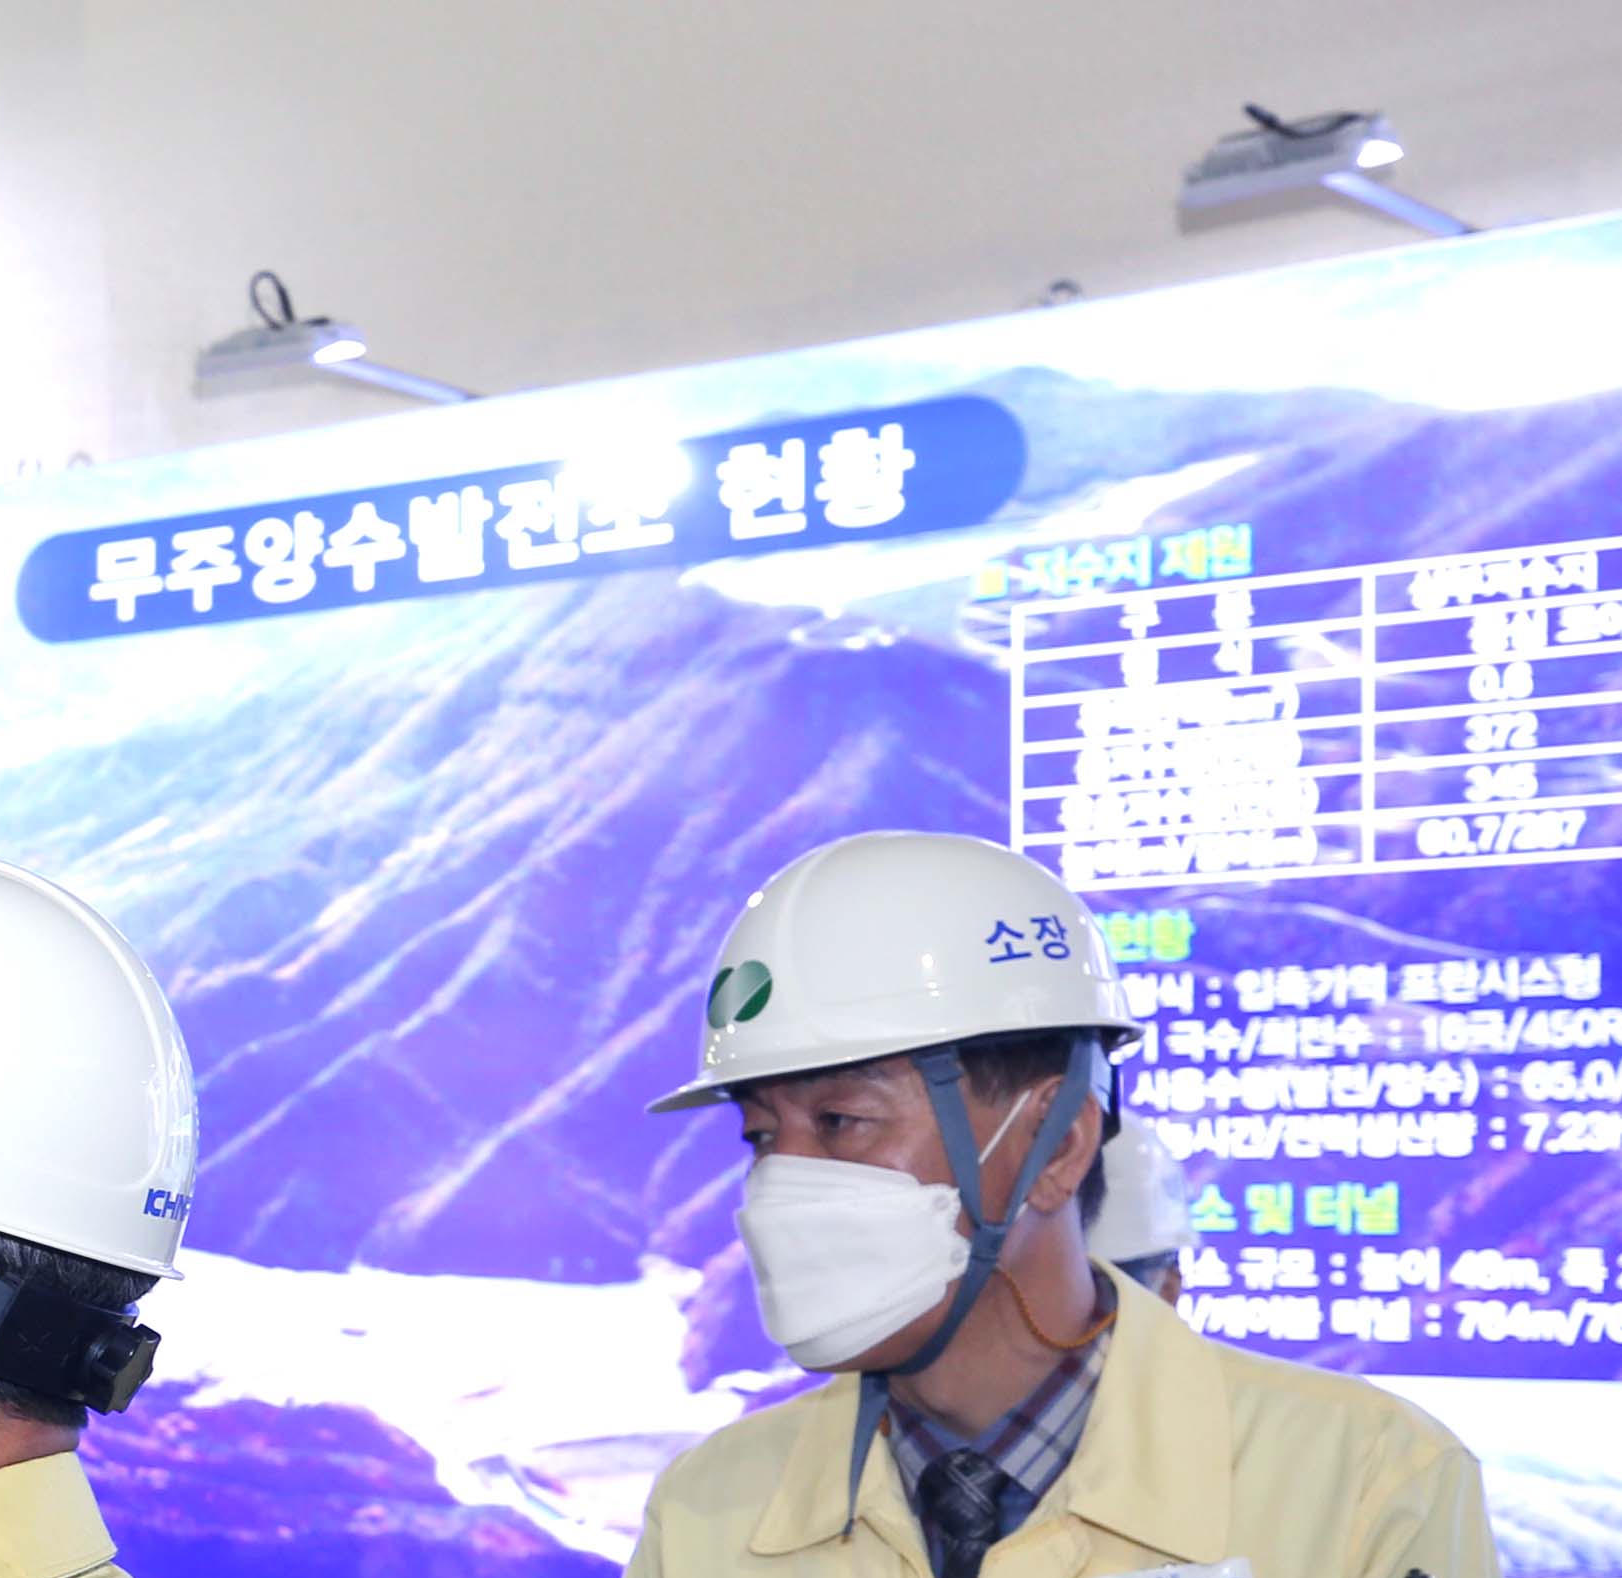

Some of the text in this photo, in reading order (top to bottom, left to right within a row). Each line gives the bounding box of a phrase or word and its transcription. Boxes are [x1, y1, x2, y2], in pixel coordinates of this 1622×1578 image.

[89, 424, 915, 622] 무주양수발전소 현황
[1464, 711, 1538, 752] 372
[984, 914, 1070, 964] 소장
[1245, 1182, 1294, 1235] 및
[1305, 1181, 1399, 1236] 터널
[1236, 1246, 1320, 1290] 규모
[1357, 1246, 1440, 1292] 높이
